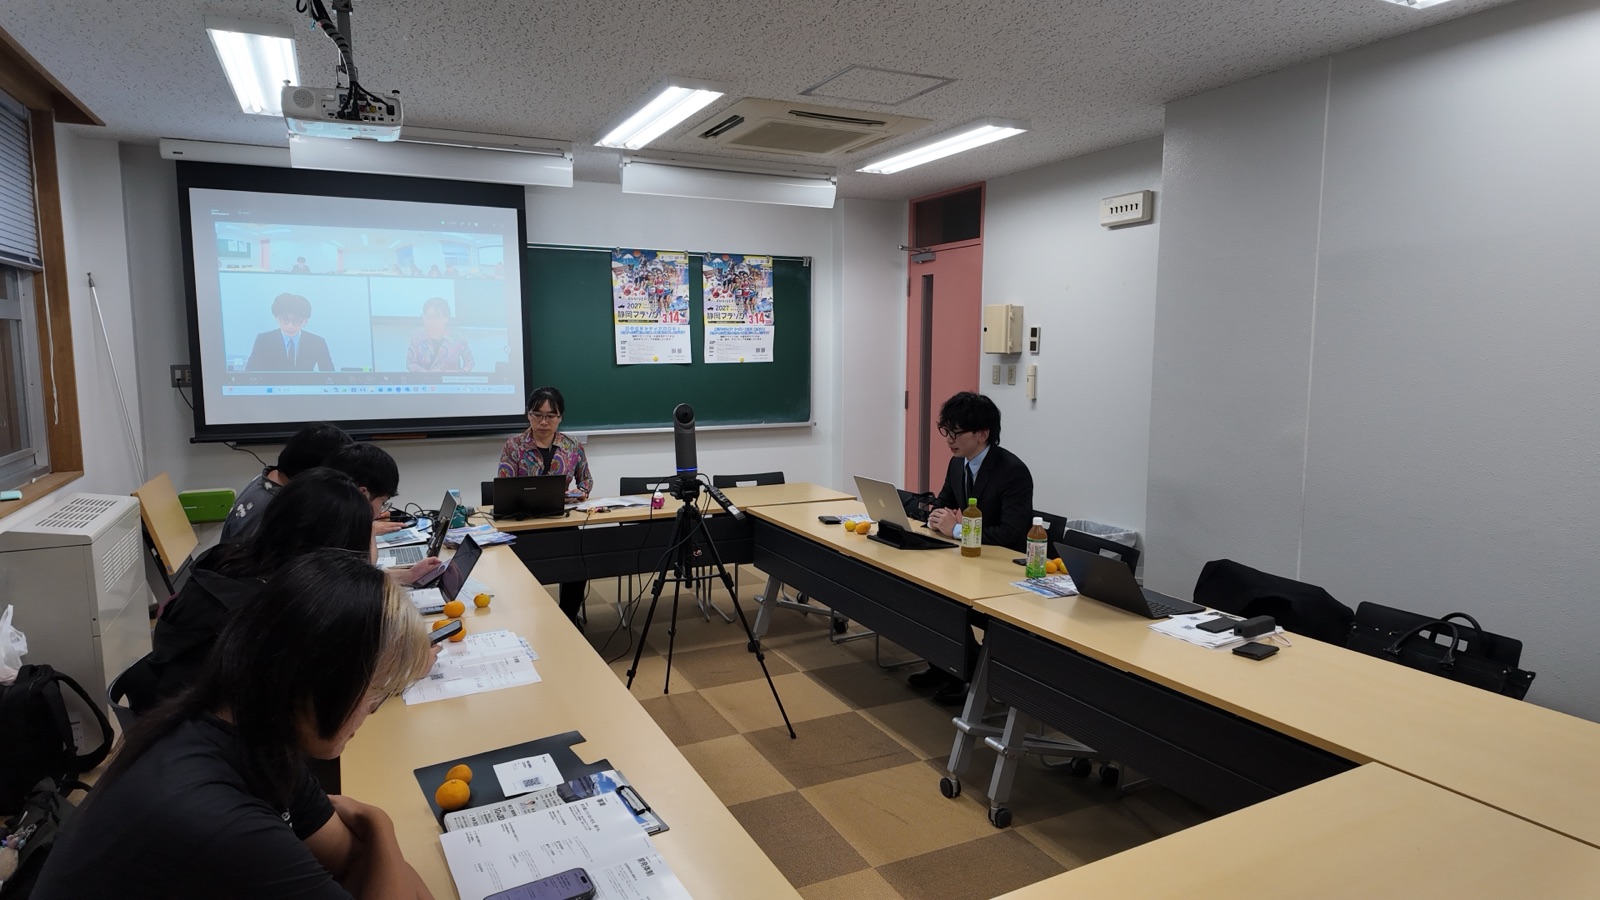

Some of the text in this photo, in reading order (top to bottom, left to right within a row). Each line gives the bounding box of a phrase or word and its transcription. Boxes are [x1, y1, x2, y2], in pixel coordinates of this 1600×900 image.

[617, 310, 659, 319] 静岡マラソン
[662, 310, 679, 323] 3.14
[706, 312, 745, 320] 静岡マラソン
[748, 312, 765, 324] 3.14
